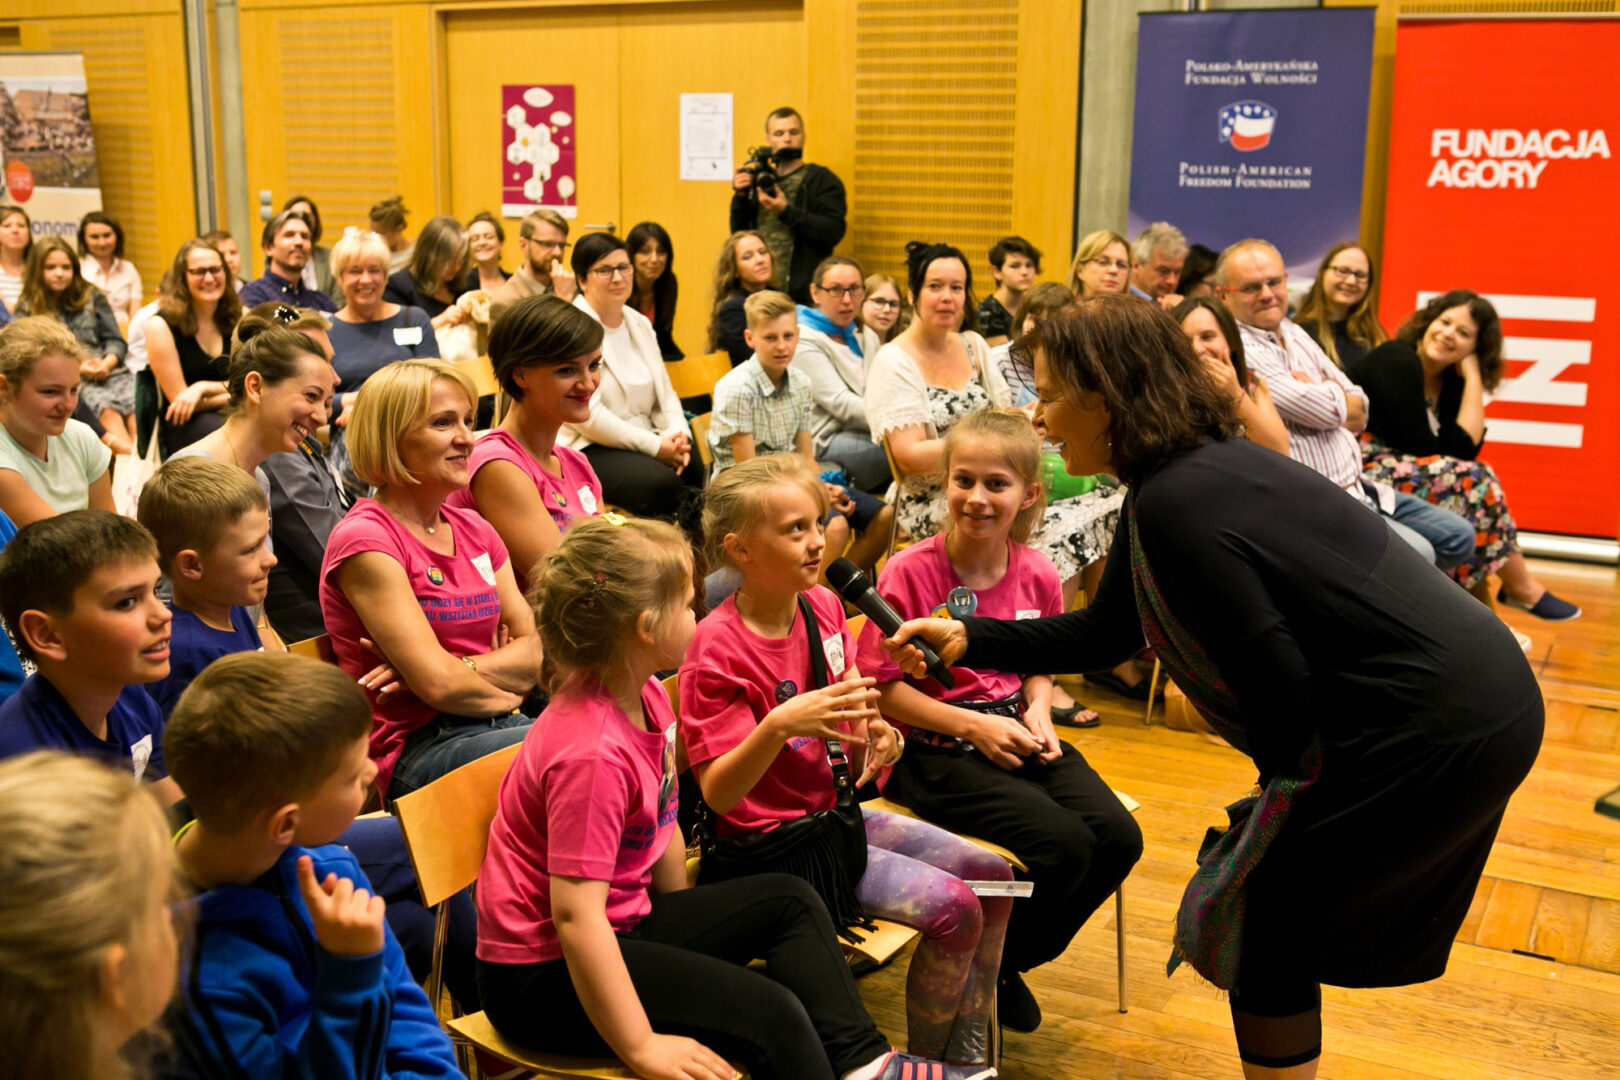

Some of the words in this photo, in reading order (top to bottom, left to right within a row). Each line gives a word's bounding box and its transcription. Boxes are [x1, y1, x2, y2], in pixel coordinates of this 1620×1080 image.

[1185, 72, 1246, 86] FUNDACJA
[1431, 129, 1611, 159] FUNDACJA
[1179, 174, 1232, 187] FREEDOM
[1235, 175, 1311, 189] FOUNDATION
[1426, 159, 1548, 188] AGORY
[31, 220, 77, 236] onom
